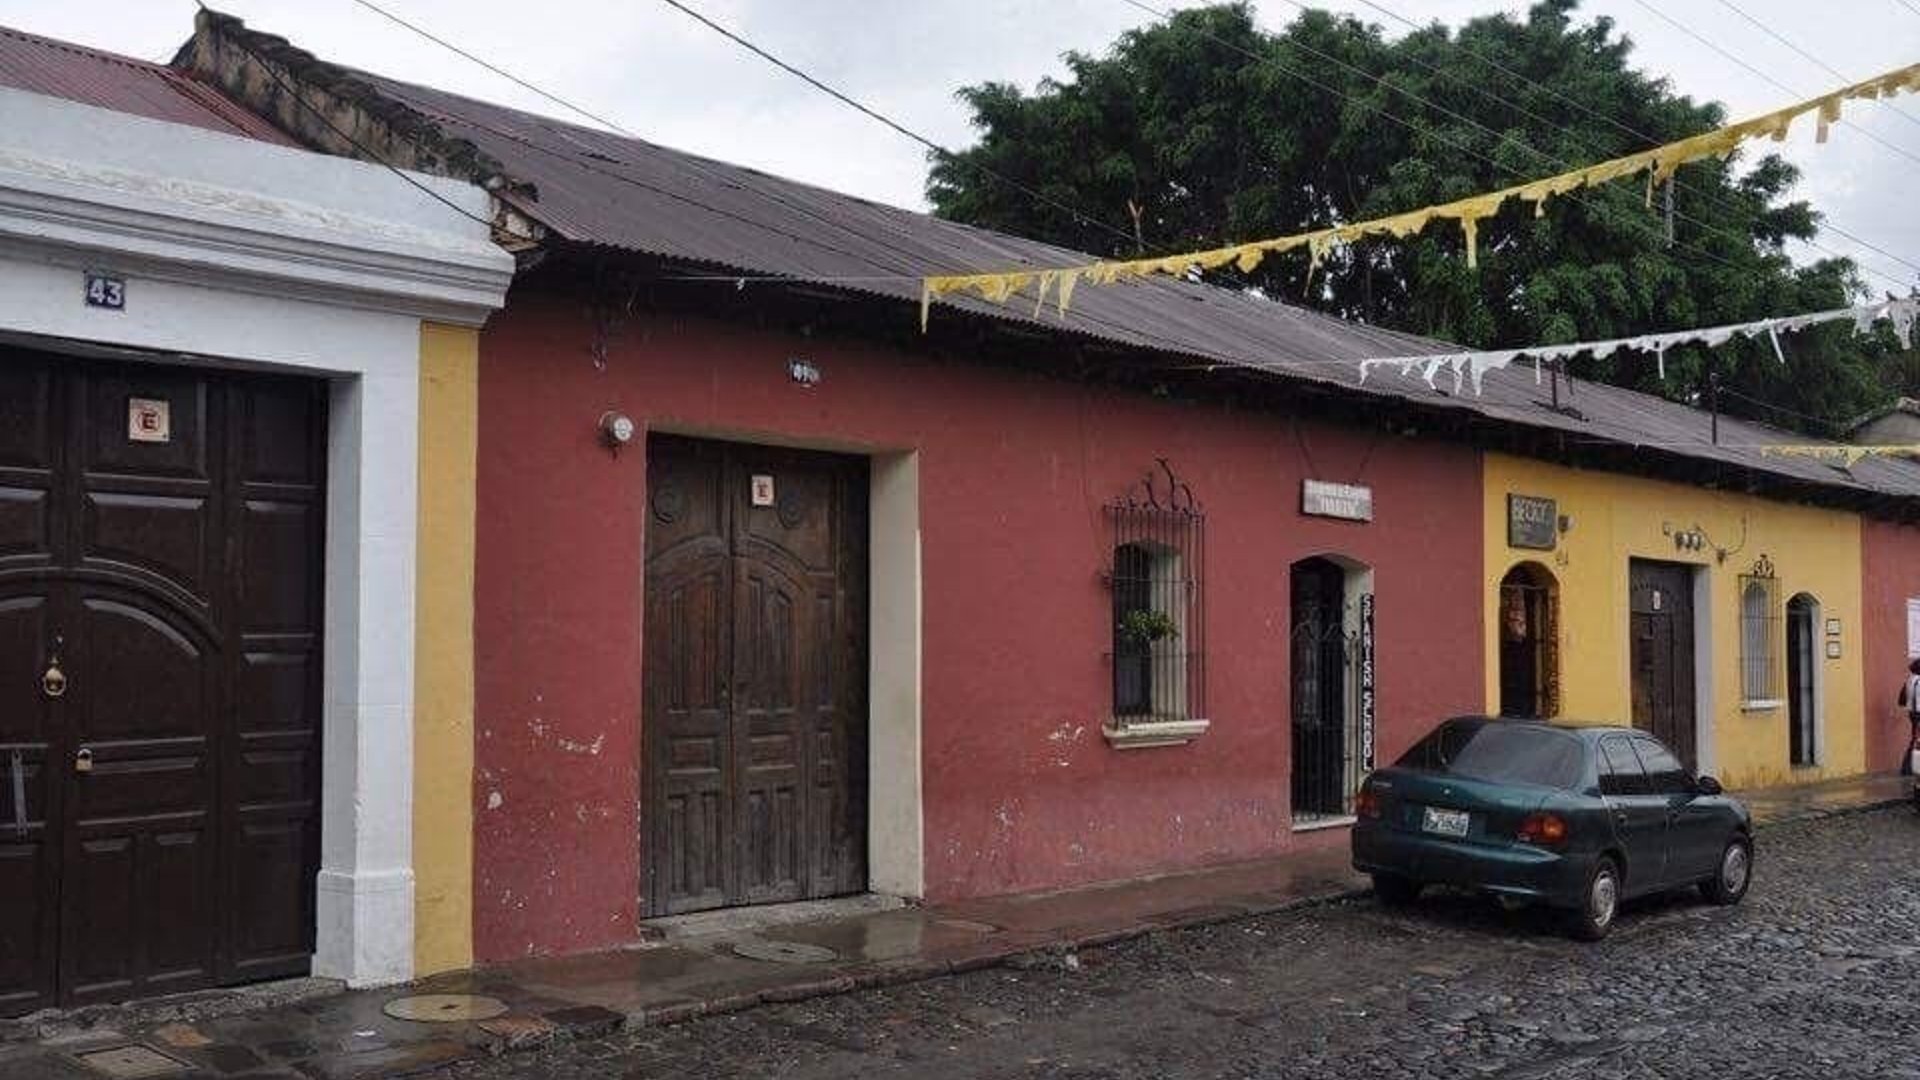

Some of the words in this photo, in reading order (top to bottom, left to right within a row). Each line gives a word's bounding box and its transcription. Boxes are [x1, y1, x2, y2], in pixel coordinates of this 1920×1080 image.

[89, 278, 123, 306] 43
[1363, 593, 1372, 687] SPANISH
[1363, 691, 1373, 770] SCHOOL
